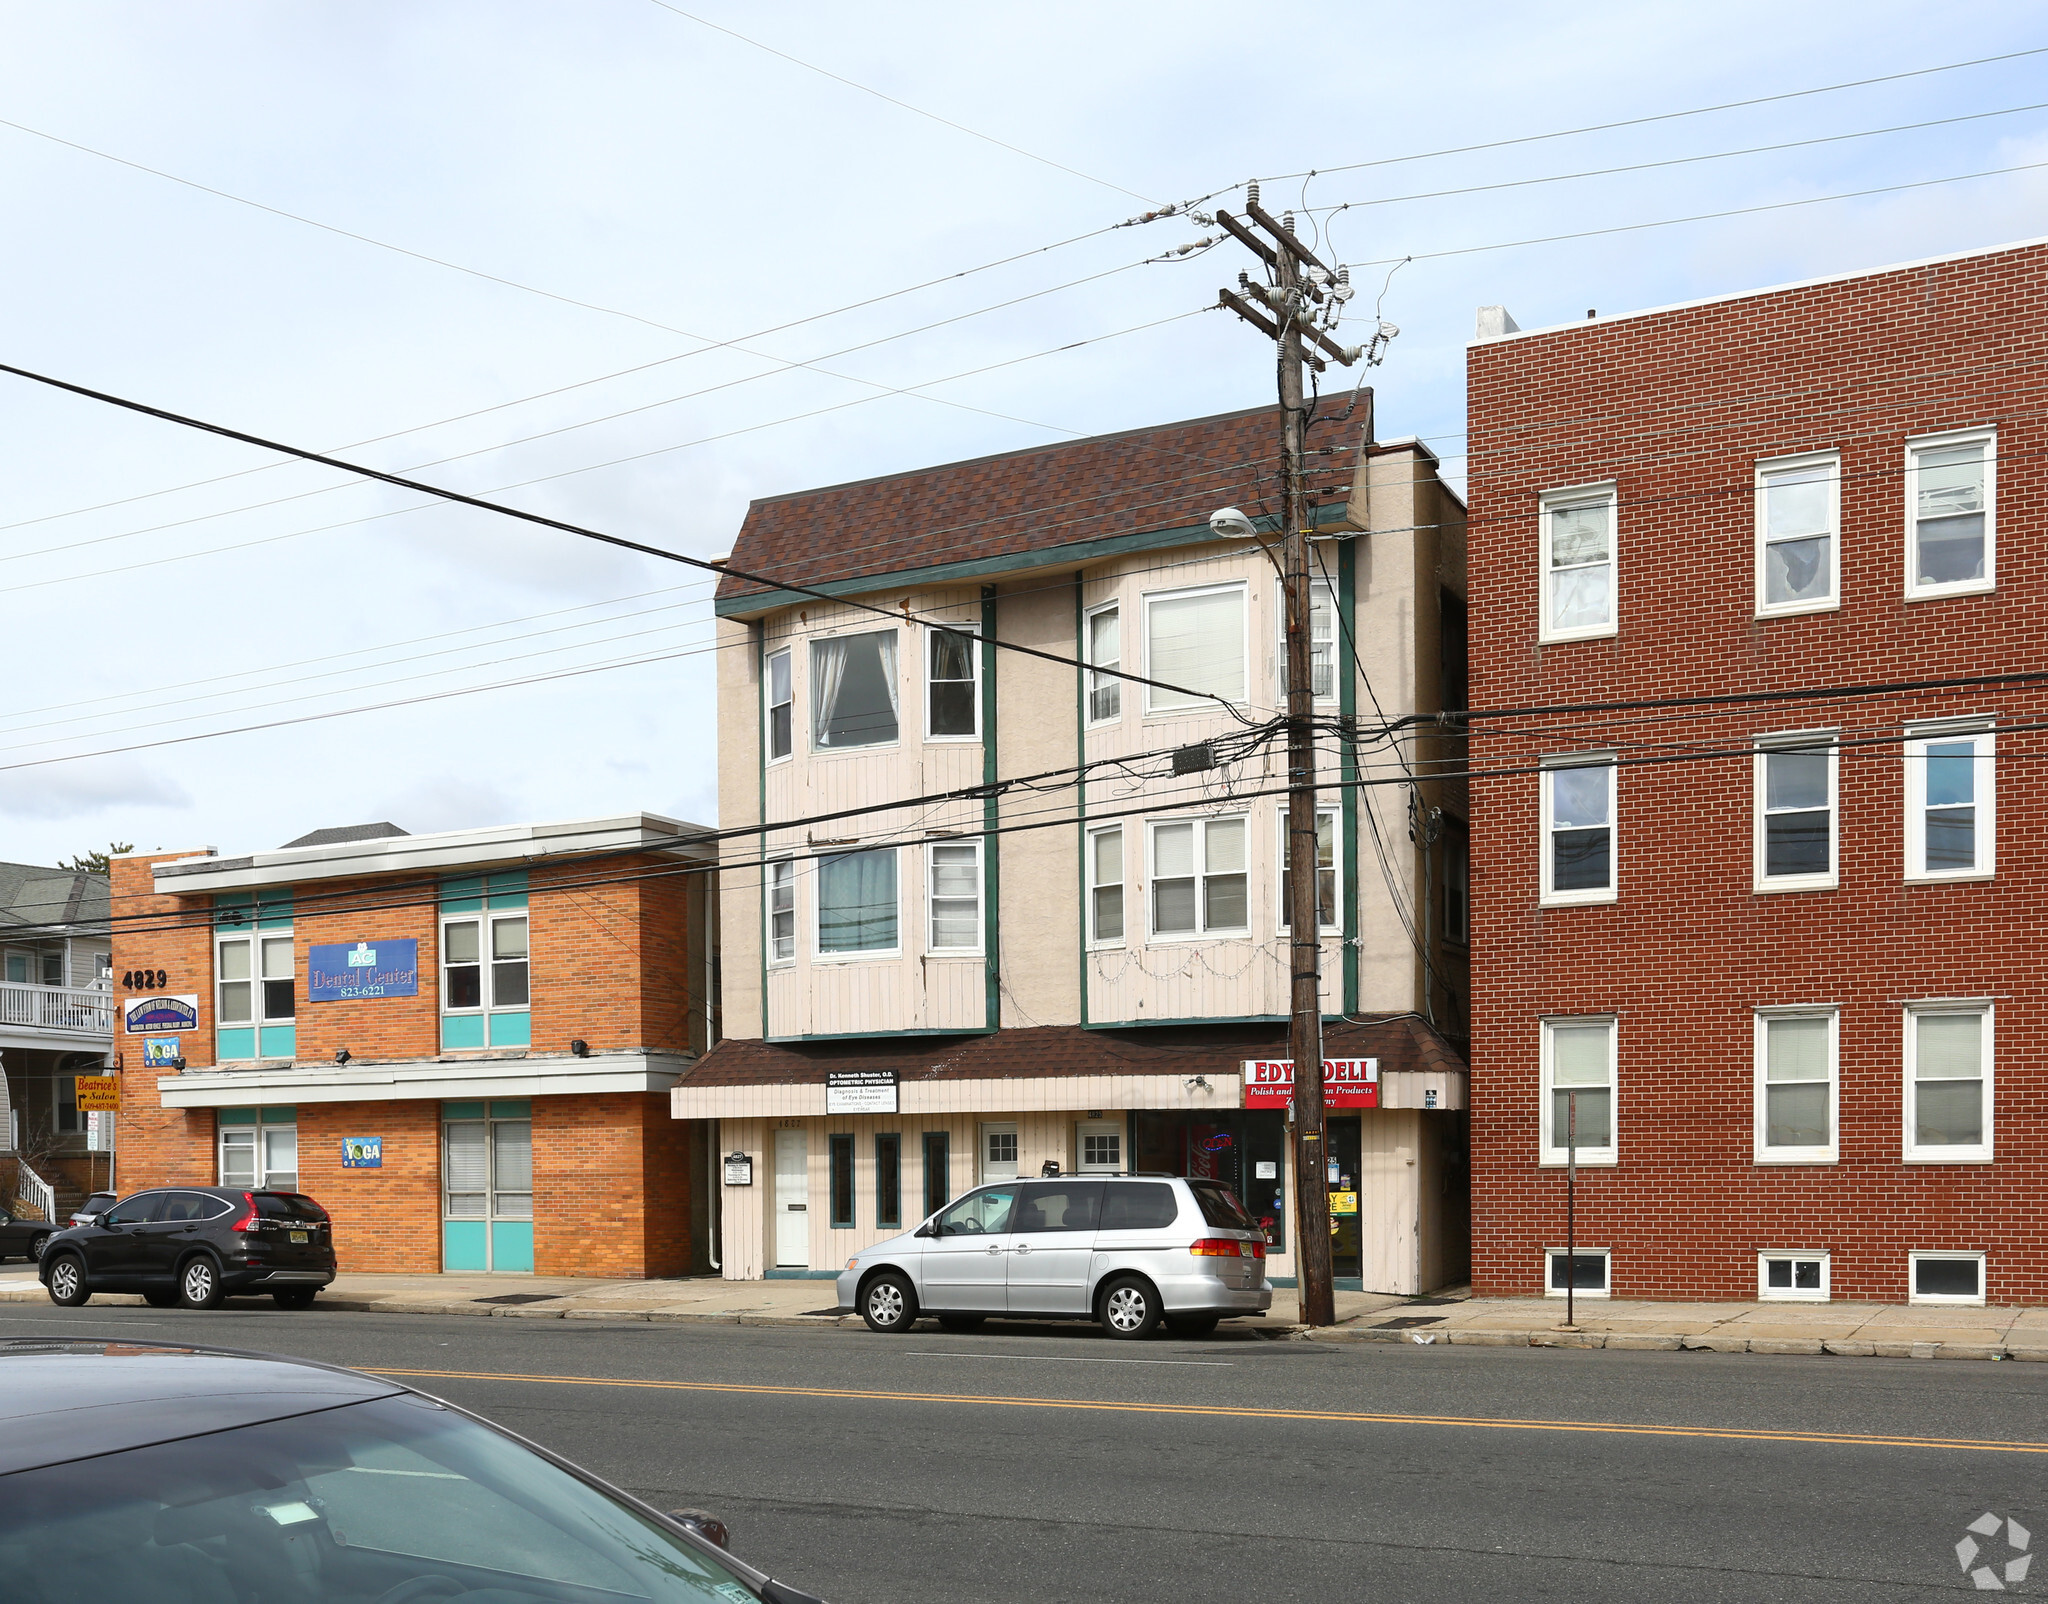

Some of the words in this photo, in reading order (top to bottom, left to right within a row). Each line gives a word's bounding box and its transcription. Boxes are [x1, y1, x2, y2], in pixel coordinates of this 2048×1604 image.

[352, 952, 374, 965] AC
[122, 969, 166, 990] 4829
[313, 968, 360, 989] Dental
[366, 967, 414, 986] Center
[340, 986, 385, 997] 823-6221
[147, 1044, 178, 1059] YOGA
[1255, 1062, 1295, 1082] EDY
[1323, 1061, 1368, 1080] DELI
[78, 1078, 117, 1090] Beatrice's
[1251, 1087, 1274, 1095] Polish
[1276, 1087, 1292, 1095] and
[1336, 1086, 1372, 1095] Products
[89, 1092, 116, 1100] Salon
[1202, 1137, 1232, 1148] OPEN
[346, 1144, 380, 1160] YOGA
